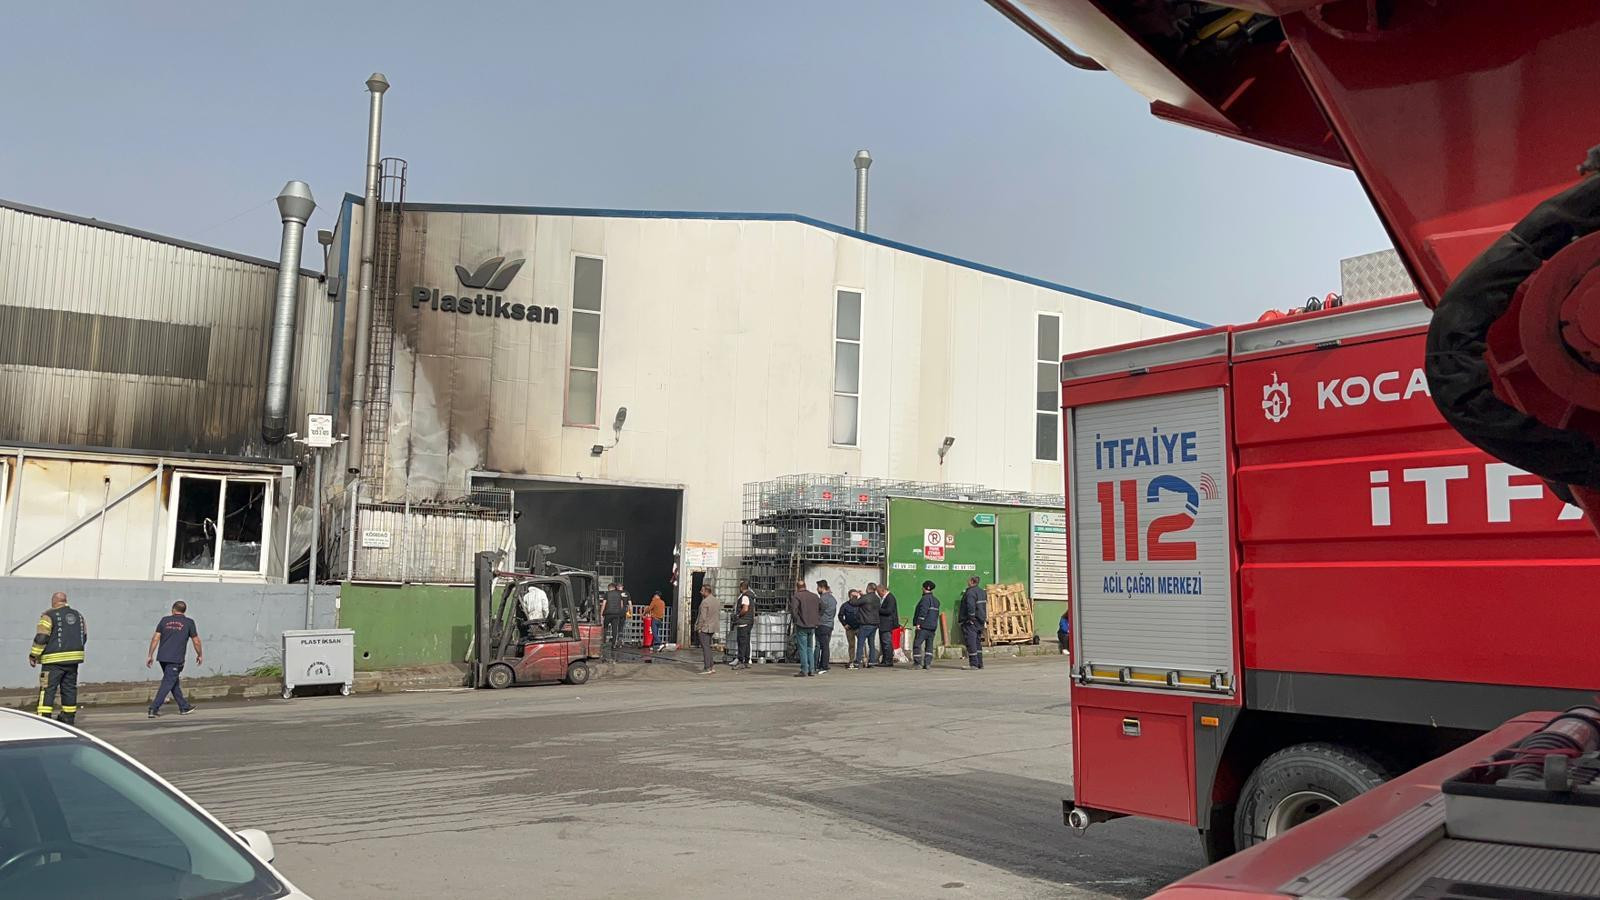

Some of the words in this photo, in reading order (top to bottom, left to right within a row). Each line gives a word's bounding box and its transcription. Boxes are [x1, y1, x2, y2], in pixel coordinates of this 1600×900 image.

[411, 286, 560, 325] Plastiksan
[1095, 426, 1198, 470] İTFAİYE
[1097, 474, 1200, 562] 112
[1103, 571, 1123, 594] ACİL
[1126, 572, 1155, 599] ÇAĞRI
[1158, 571, 1202, 595] MERKEZİ
